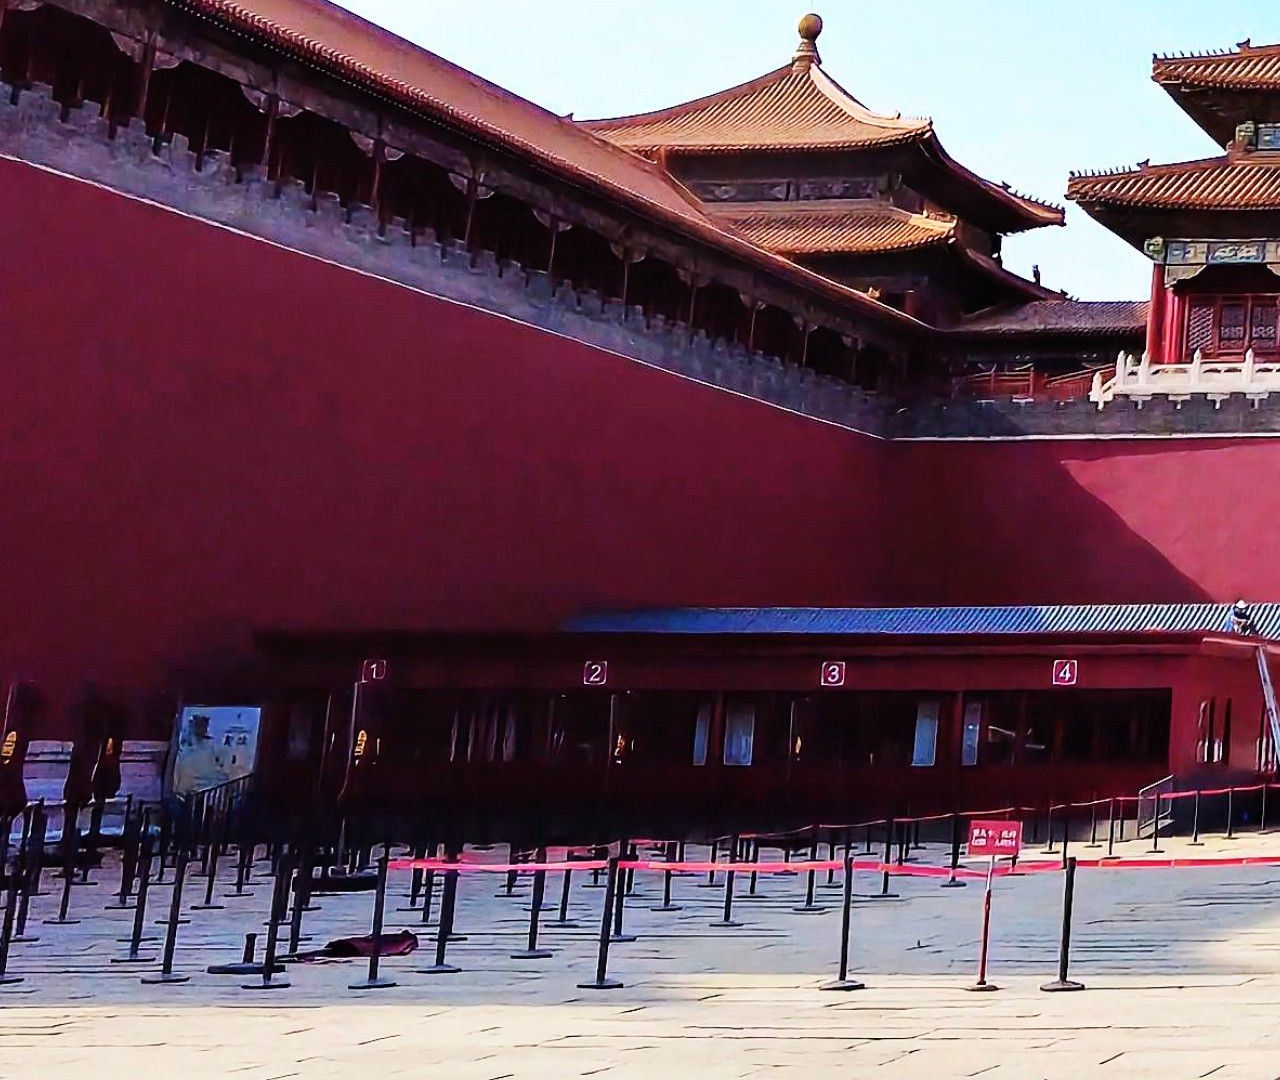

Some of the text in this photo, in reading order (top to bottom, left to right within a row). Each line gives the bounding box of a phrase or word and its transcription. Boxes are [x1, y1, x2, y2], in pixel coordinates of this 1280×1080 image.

[370, 663, 377, 679] 1
[589, 664, 601, 681] 2
[828, 665, 839, 682] 3
[1059, 663, 1071, 681] 4
